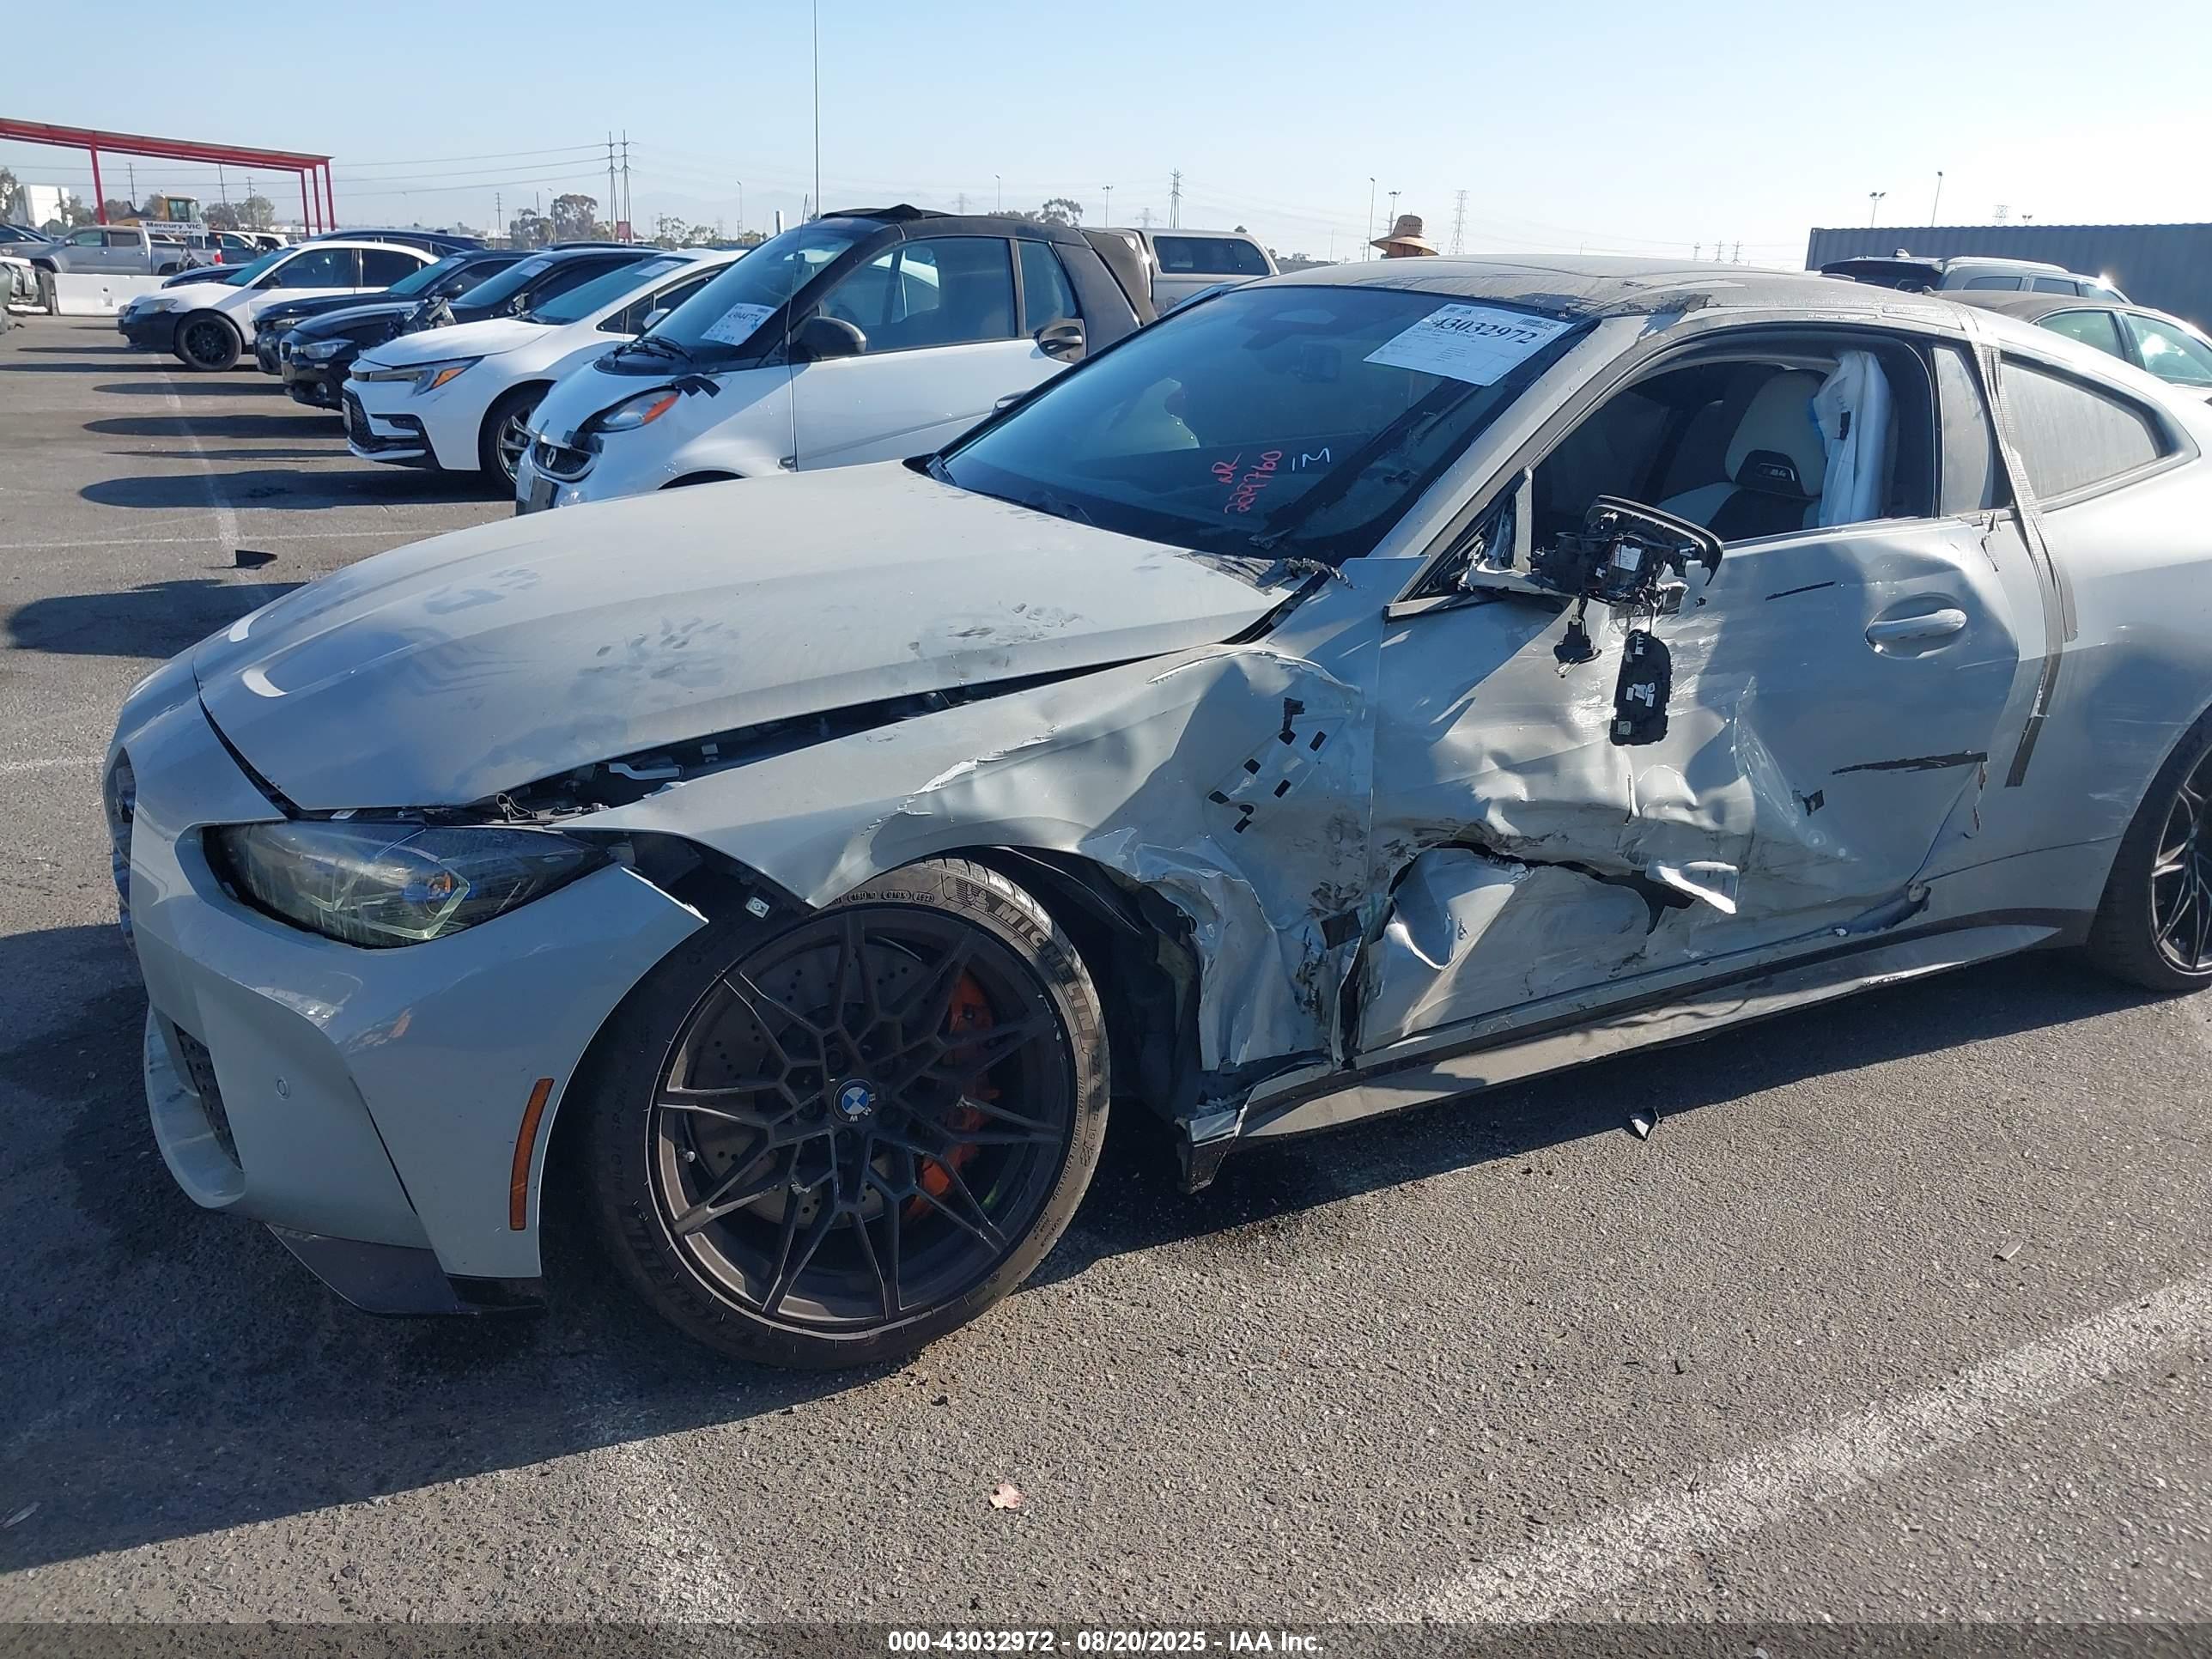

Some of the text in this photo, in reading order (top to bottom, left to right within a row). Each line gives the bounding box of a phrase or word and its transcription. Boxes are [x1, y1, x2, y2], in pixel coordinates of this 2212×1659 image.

[1431, 316, 1538, 344] 43032972
[994, 902, 1096, 1031] MICHELIN
[849, 1093, 876, 1122] BMW
